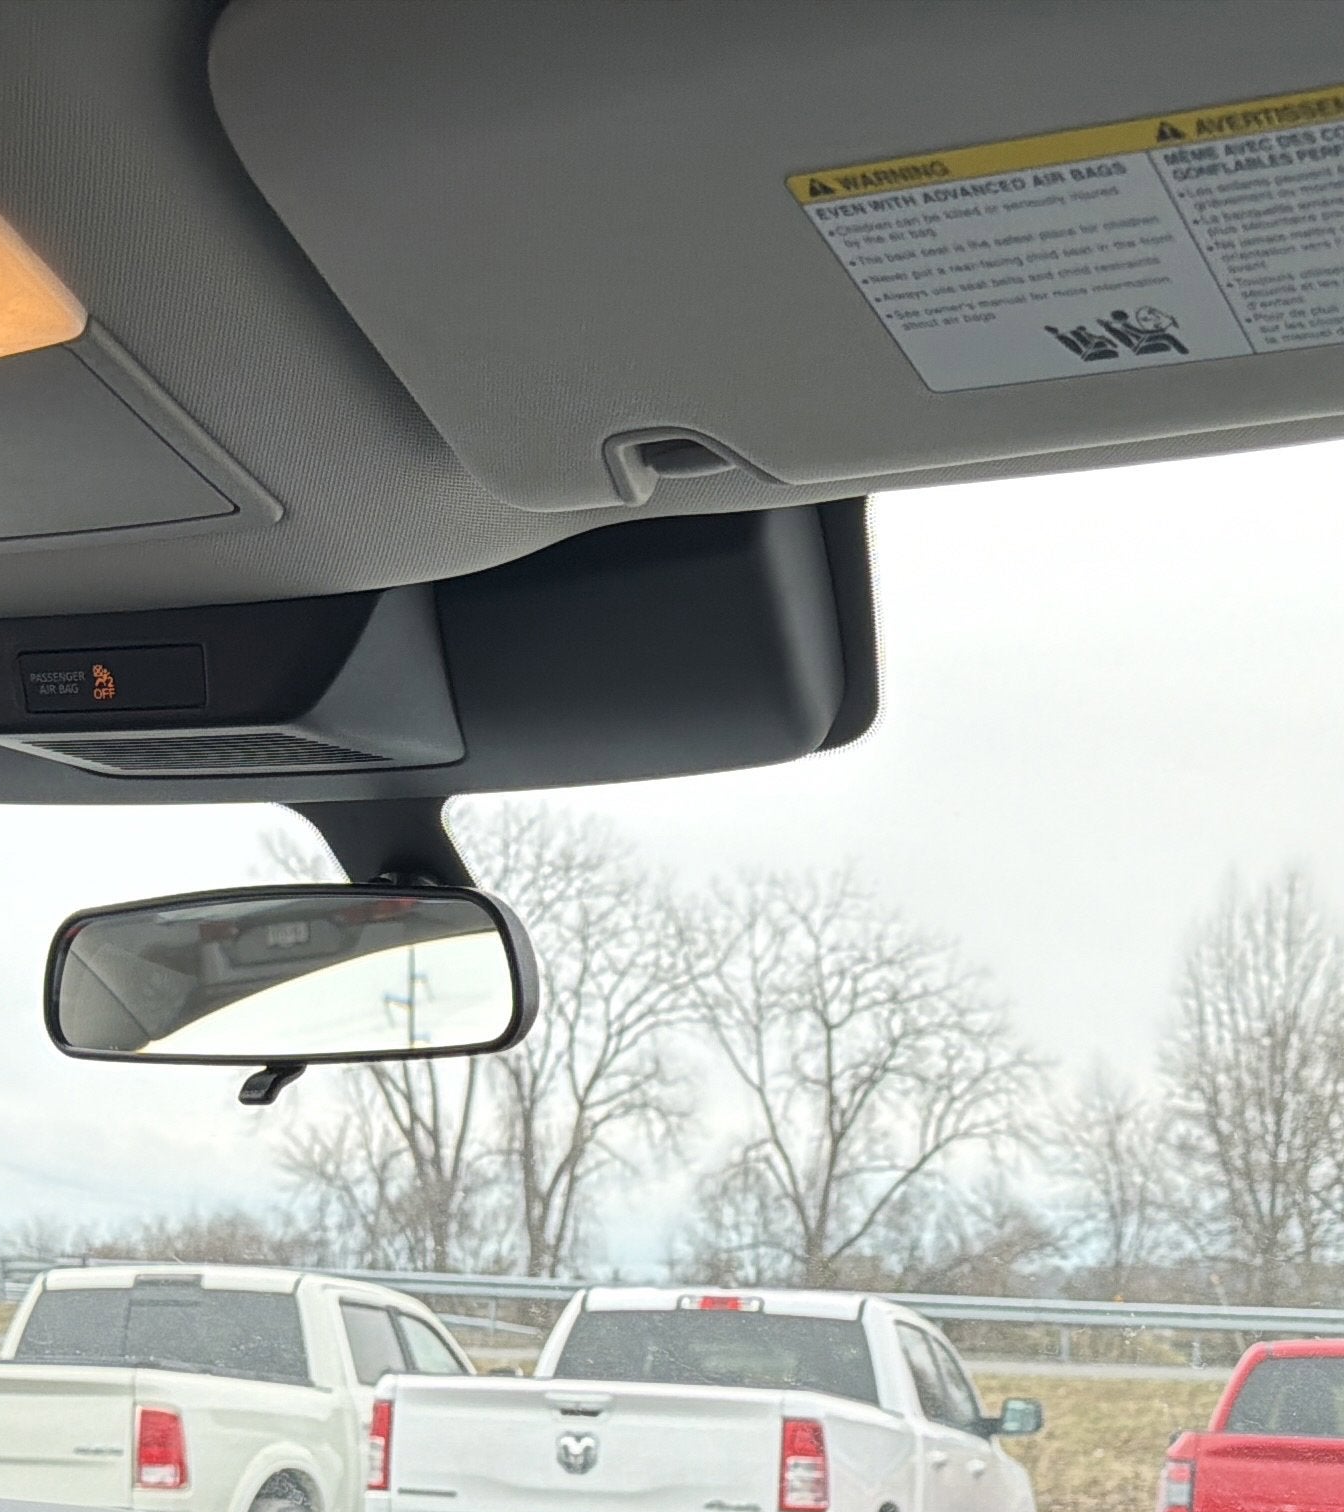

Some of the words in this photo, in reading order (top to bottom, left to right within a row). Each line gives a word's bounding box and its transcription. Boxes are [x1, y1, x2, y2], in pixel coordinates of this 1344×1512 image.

[835, 160, 951, 192] WARNING
[813, 202, 869, 222] EVEN
[866, 193, 919, 213] WITH
[918, 176, 1028, 205] ADVANCED
[1028, 170, 1067, 188] AIR
[1067, 160, 1128, 182] BAGS
[30, 671, 85, 682] PASSENGER
[39, 685, 56, 694] AIR
[59, 684, 78, 694] BAG
[94, 688, 115, 700] OFF
